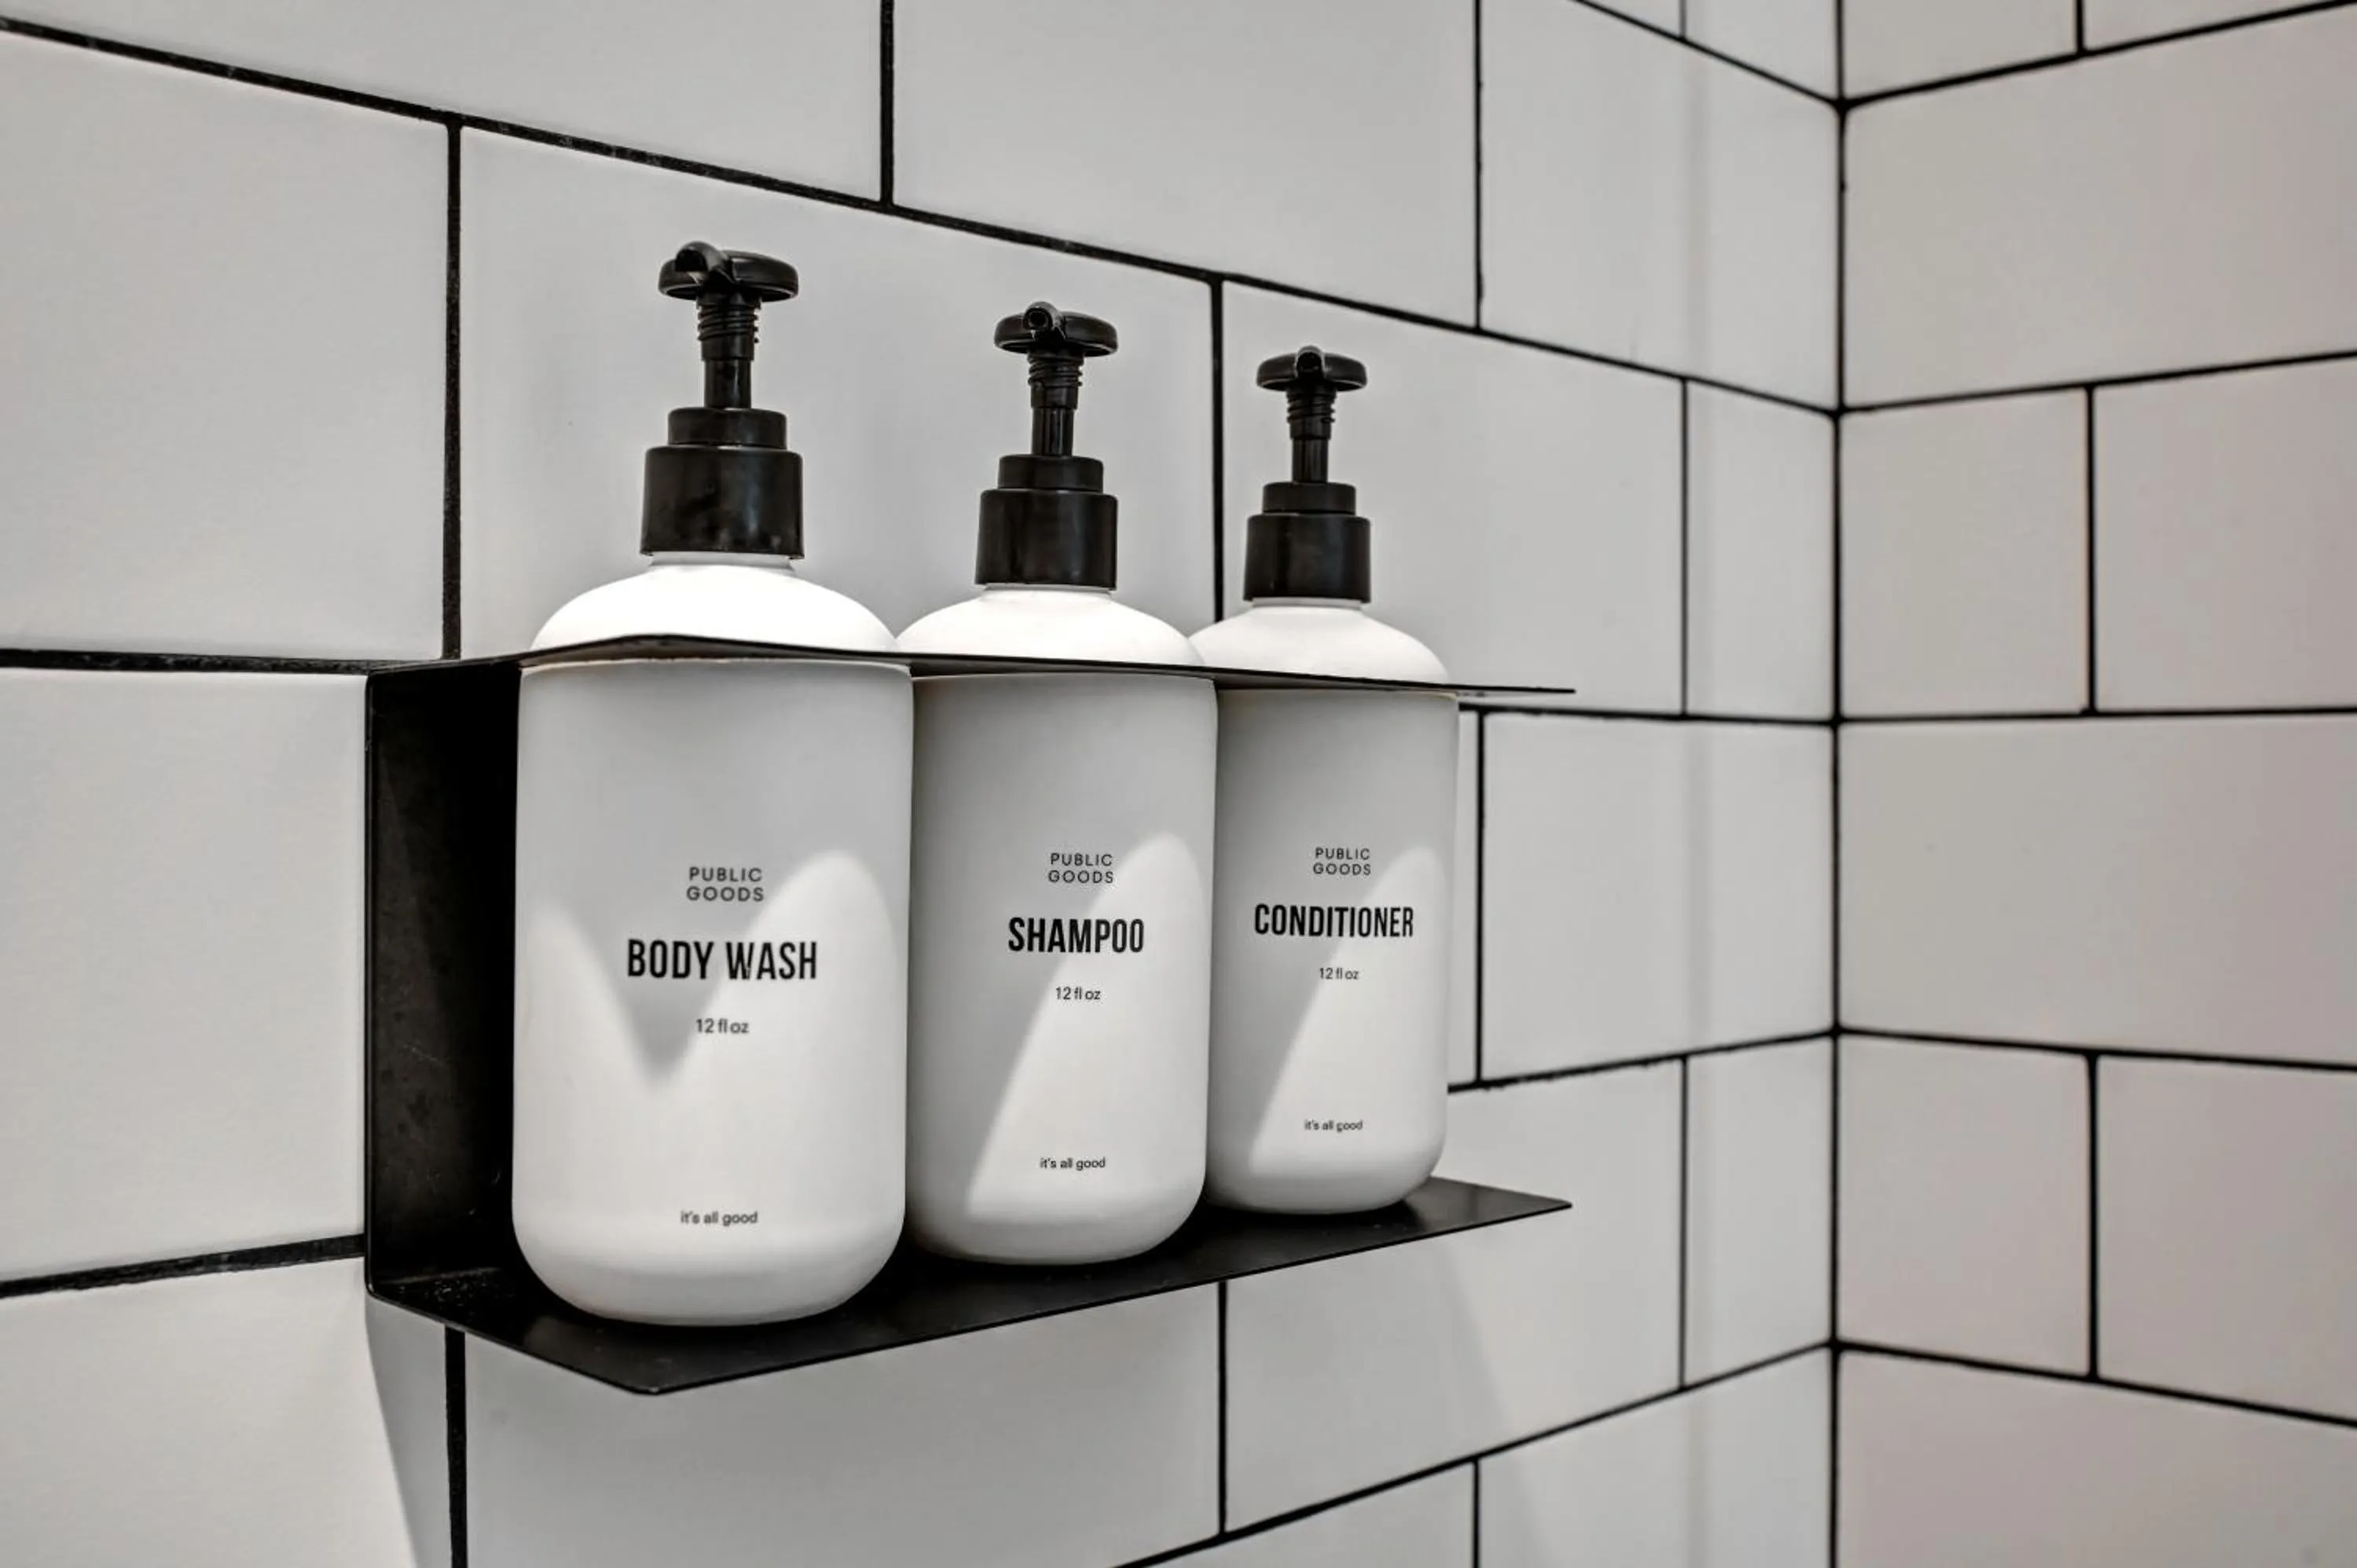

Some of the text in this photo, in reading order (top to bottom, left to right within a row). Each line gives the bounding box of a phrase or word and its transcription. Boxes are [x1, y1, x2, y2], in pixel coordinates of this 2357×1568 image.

[1050, 852, 1113, 867] PUBLIC
[1314, 847, 1370, 861] PUBLIC
[689, 866, 762, 883] PUBLIC
[1047, 869, 1113, 884] GOODS
[1312, 862, 1371, 877] GOODS
[686, 885, 764, 903] GOODS
[1254, 903, 1414, 938] CONDITIONER
[1008, 917, 1145, 954] SHAMPOO
[627, 938, 817, 980] BODY WASH
[1319, 967, 1334, 980] 12
[1055, 986, 1072, 1001] 12
[696, 1017, 715, 1034] 12
[1321, 1119, 1334, 1130] all
[1336, 1119, 1363, 1134] good
[1060, 1157, 1073, 1169] all
[1076, 1157, 1106, 1171] good
[703, 1211, 719, 1225] all
[721, 1211, 758, 1228] good
